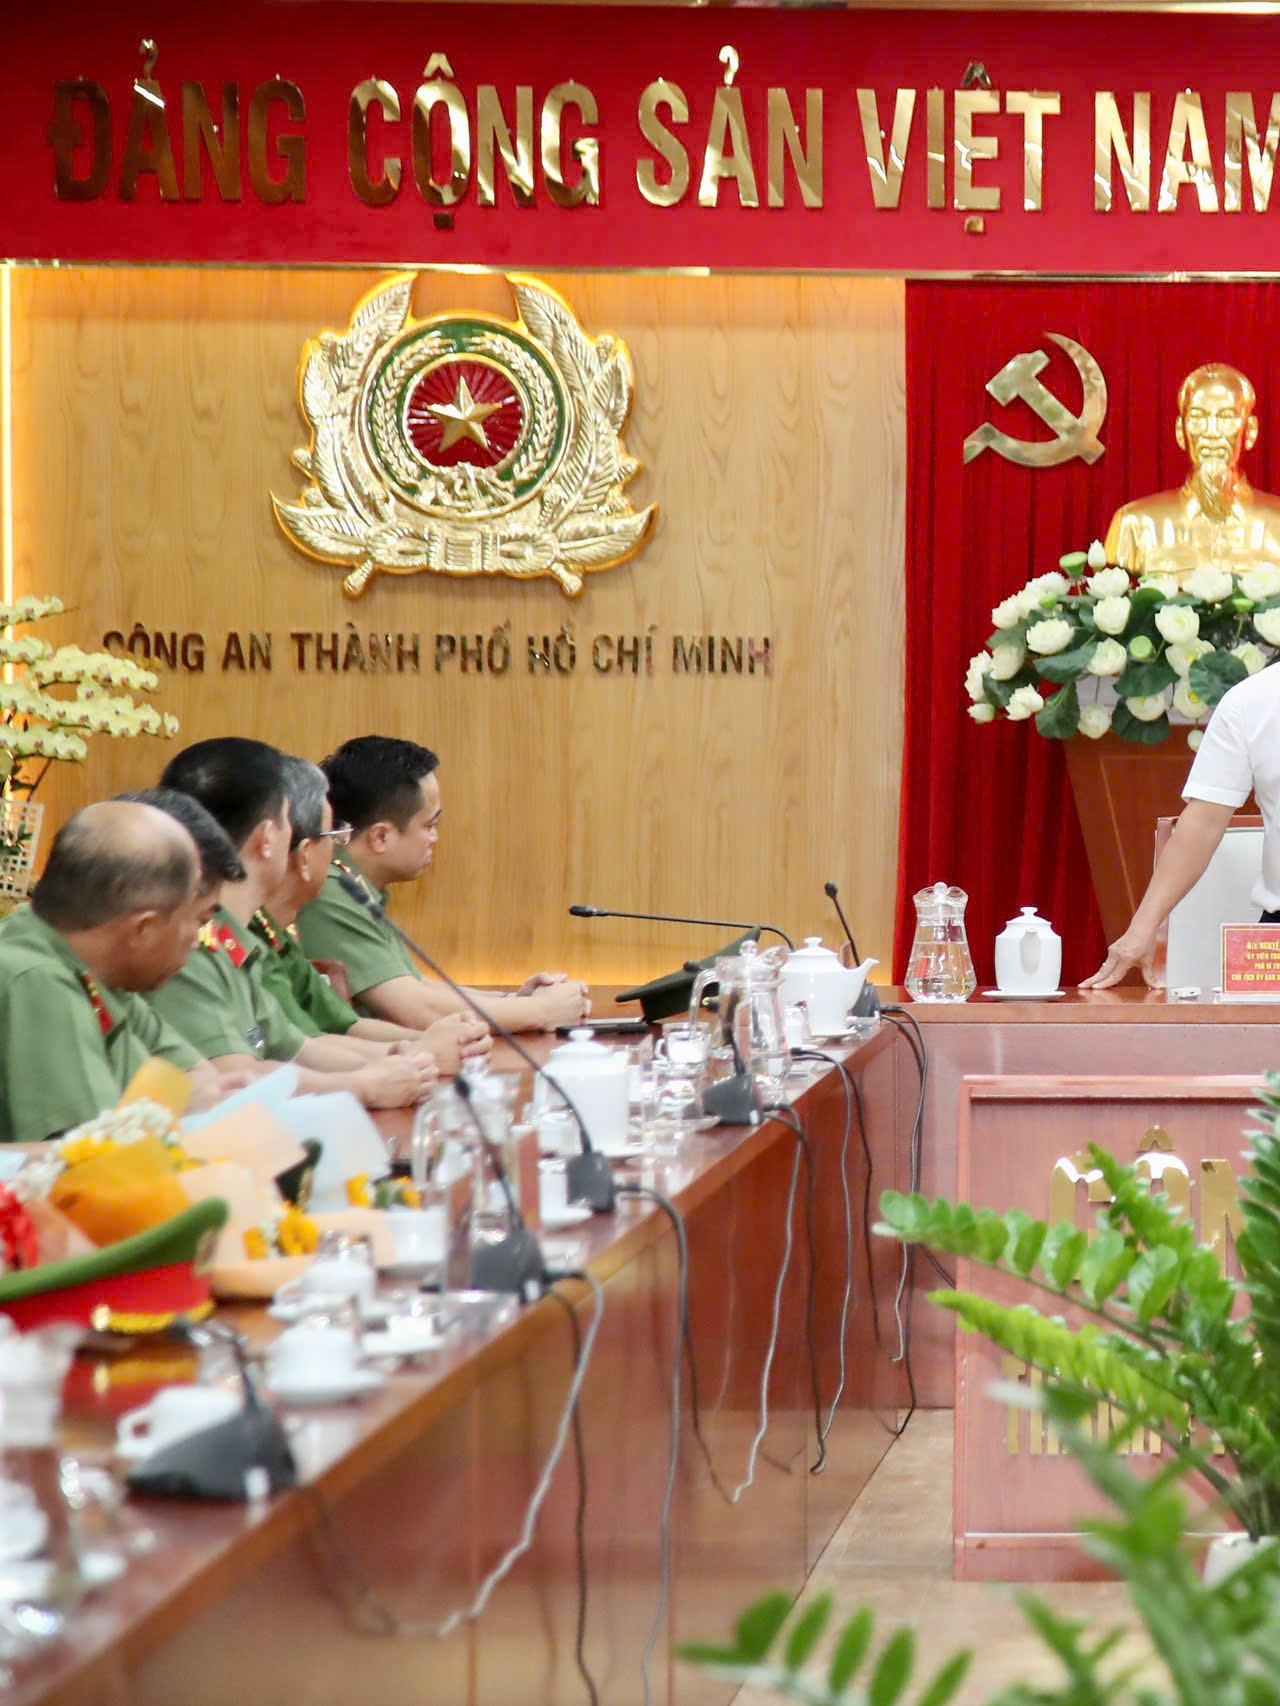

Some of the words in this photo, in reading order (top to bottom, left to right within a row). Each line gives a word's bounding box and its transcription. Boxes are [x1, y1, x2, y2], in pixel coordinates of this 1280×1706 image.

[46, 38, 308, 203] ĐẢNG
[347, 52, 600, 230] CỘNG
[636, 45, 824, 210] SẢN
[855, 62, 1061, 234] VIỆT
[221, 631, 272, 671] AN
[290, 620, 419, 672] THÀNH
[434, 618, 512, 674] PHỐ
[592, 622, 658, 674] CHÍ
[672, 633, 774, 675] MINH
